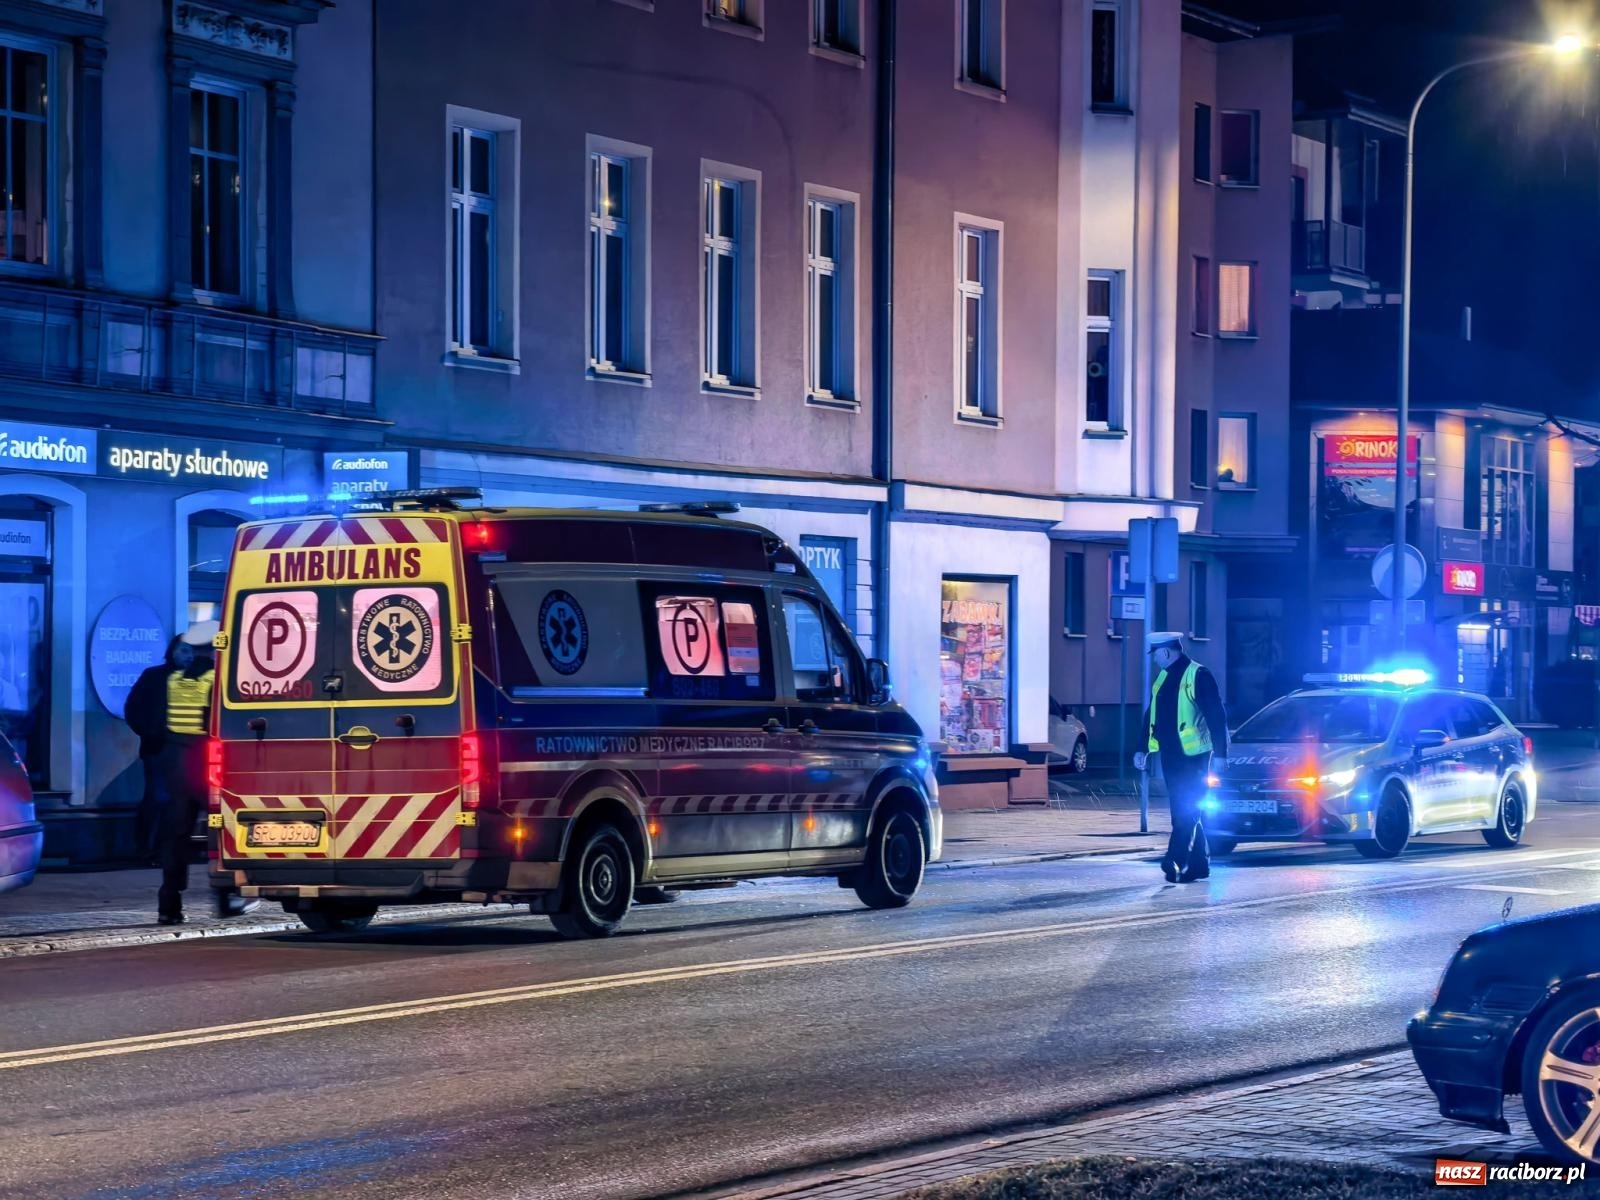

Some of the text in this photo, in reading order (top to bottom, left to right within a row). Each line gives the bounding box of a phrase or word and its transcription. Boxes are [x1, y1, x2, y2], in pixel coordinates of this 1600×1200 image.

[10, 435, 87, 463] audiofon
[110, 446, 269, 479] aparaty słuchowe
[343, 458, 388, 469] audiofon
[0, 531, 32, 544] udiofon
[265, 547, 421, 584] AMBULANS
[266, 618, 288, 661] P
[683, 617, 699, 657] P
[106, 651, 152, 664] BADANIE
[370, 663, 419, 679] MEDYCZNE
[536, 737, 637, 753] RATOWNICTWO
[639, 737, 705, 752] MEDYCZNE
